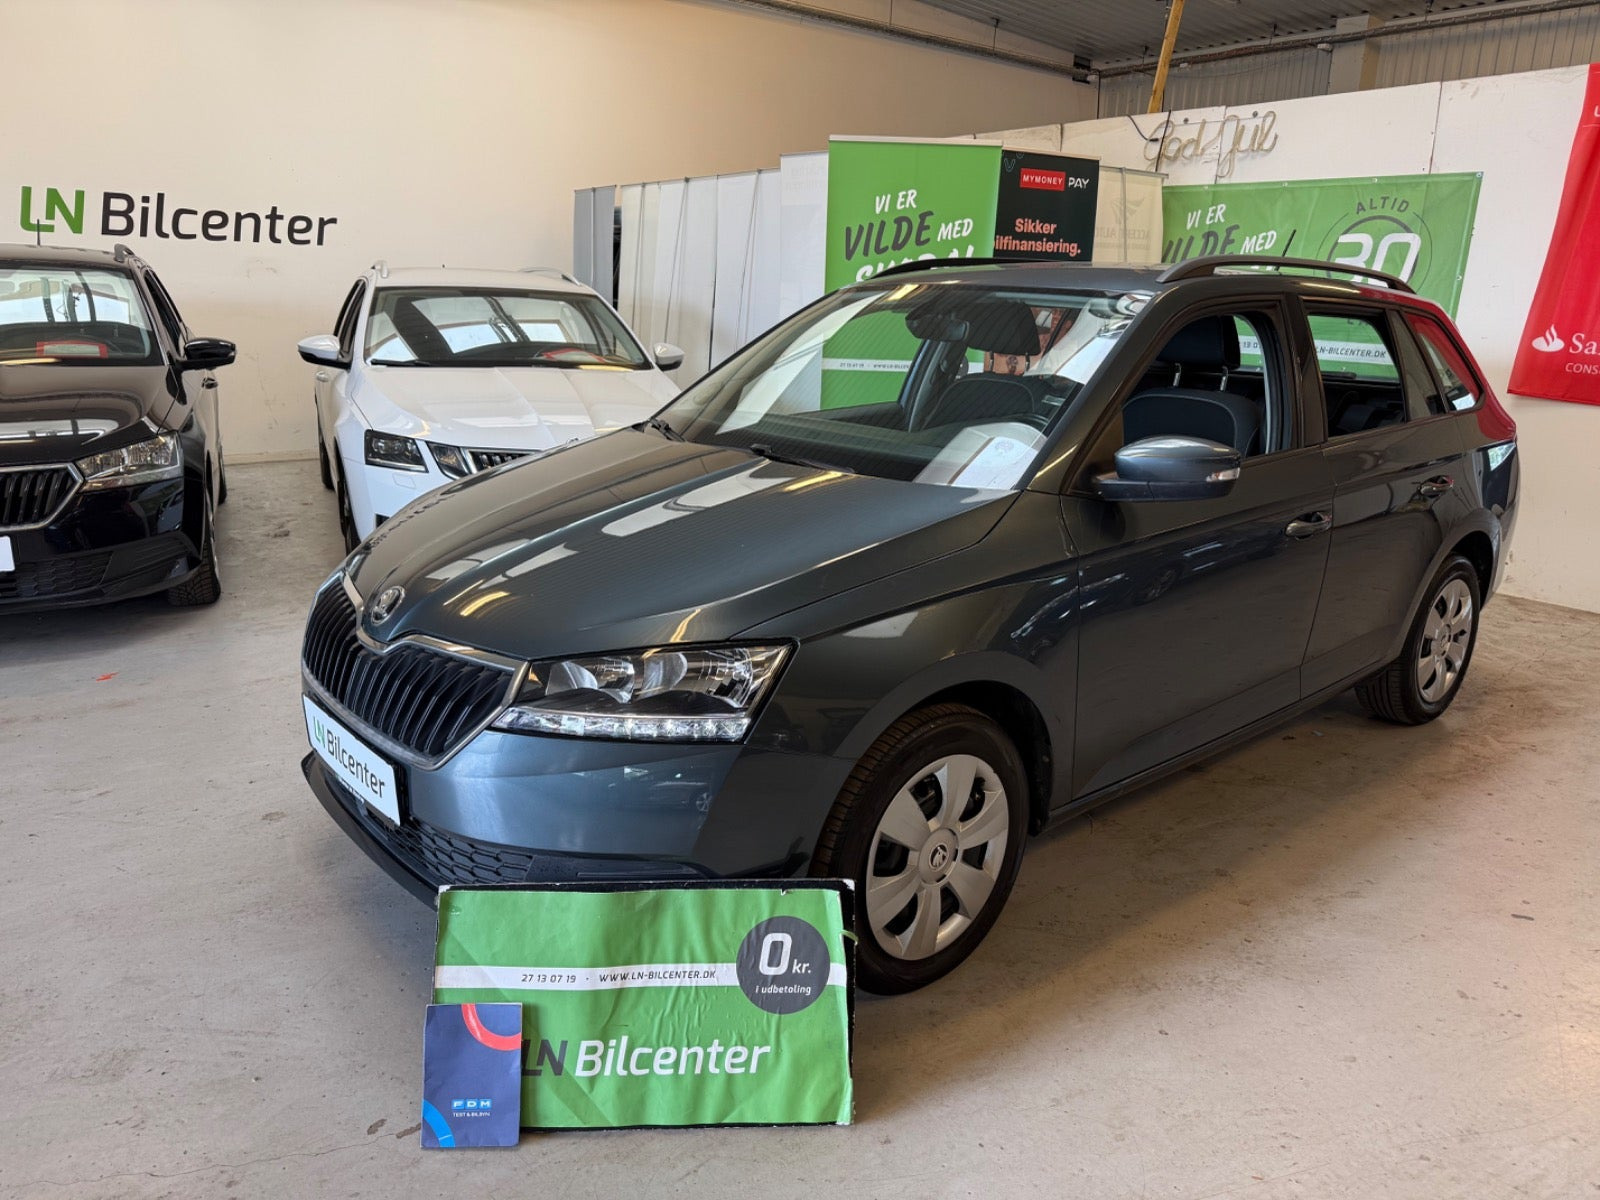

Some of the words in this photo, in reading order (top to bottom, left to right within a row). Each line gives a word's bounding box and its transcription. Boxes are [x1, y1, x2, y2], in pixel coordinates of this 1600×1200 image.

[1022, 173, 1063, 186] MYMONEY
[1068, 177, 1090, 189] PAY
[875, 194, 892, 214] VI
[896, 189, 917, 210] ER
[1356, 196, 1410, 215] ALTID
[20, 186, 85, 235] LN
[101, 191, 338, 246] Bilcenter
[1015, 218, 1057, 235] Sikker
[1186, 209, 1202, 231] VI
[1205, 203, 1227, 225] ER
[845, 210, 934, 261] VILDE
[937, 218, 974, 242] MED
[993, 235, 1081, 257] ilfinansiering.
[1240, 230, 1278, 255] MED
[1335, 232, 1422, 288] 30
[1569, 332, 1600, 356] Sa
[1565, 362, 1600, 375] CONS
[313, 716, 326, 748] LN
[327, 729, 386, 798] Bilcenter
[759, 932, 793, 976] 0
[792, 958, 812, 974] kr.
[521, 974, 534, 983] 27
[537, 974, 547, 984] 13
[550, 974, 563, 984] 07
[566, 975, 577, 984] 19
[599, 969, 717, 983] WWW.LN-BILCENTER.DK
[521, 1039, 568, 1076] LN
[575, 1035, 771, 1077] Bilcenter
[453, 1100, 490, 1108] FDM
